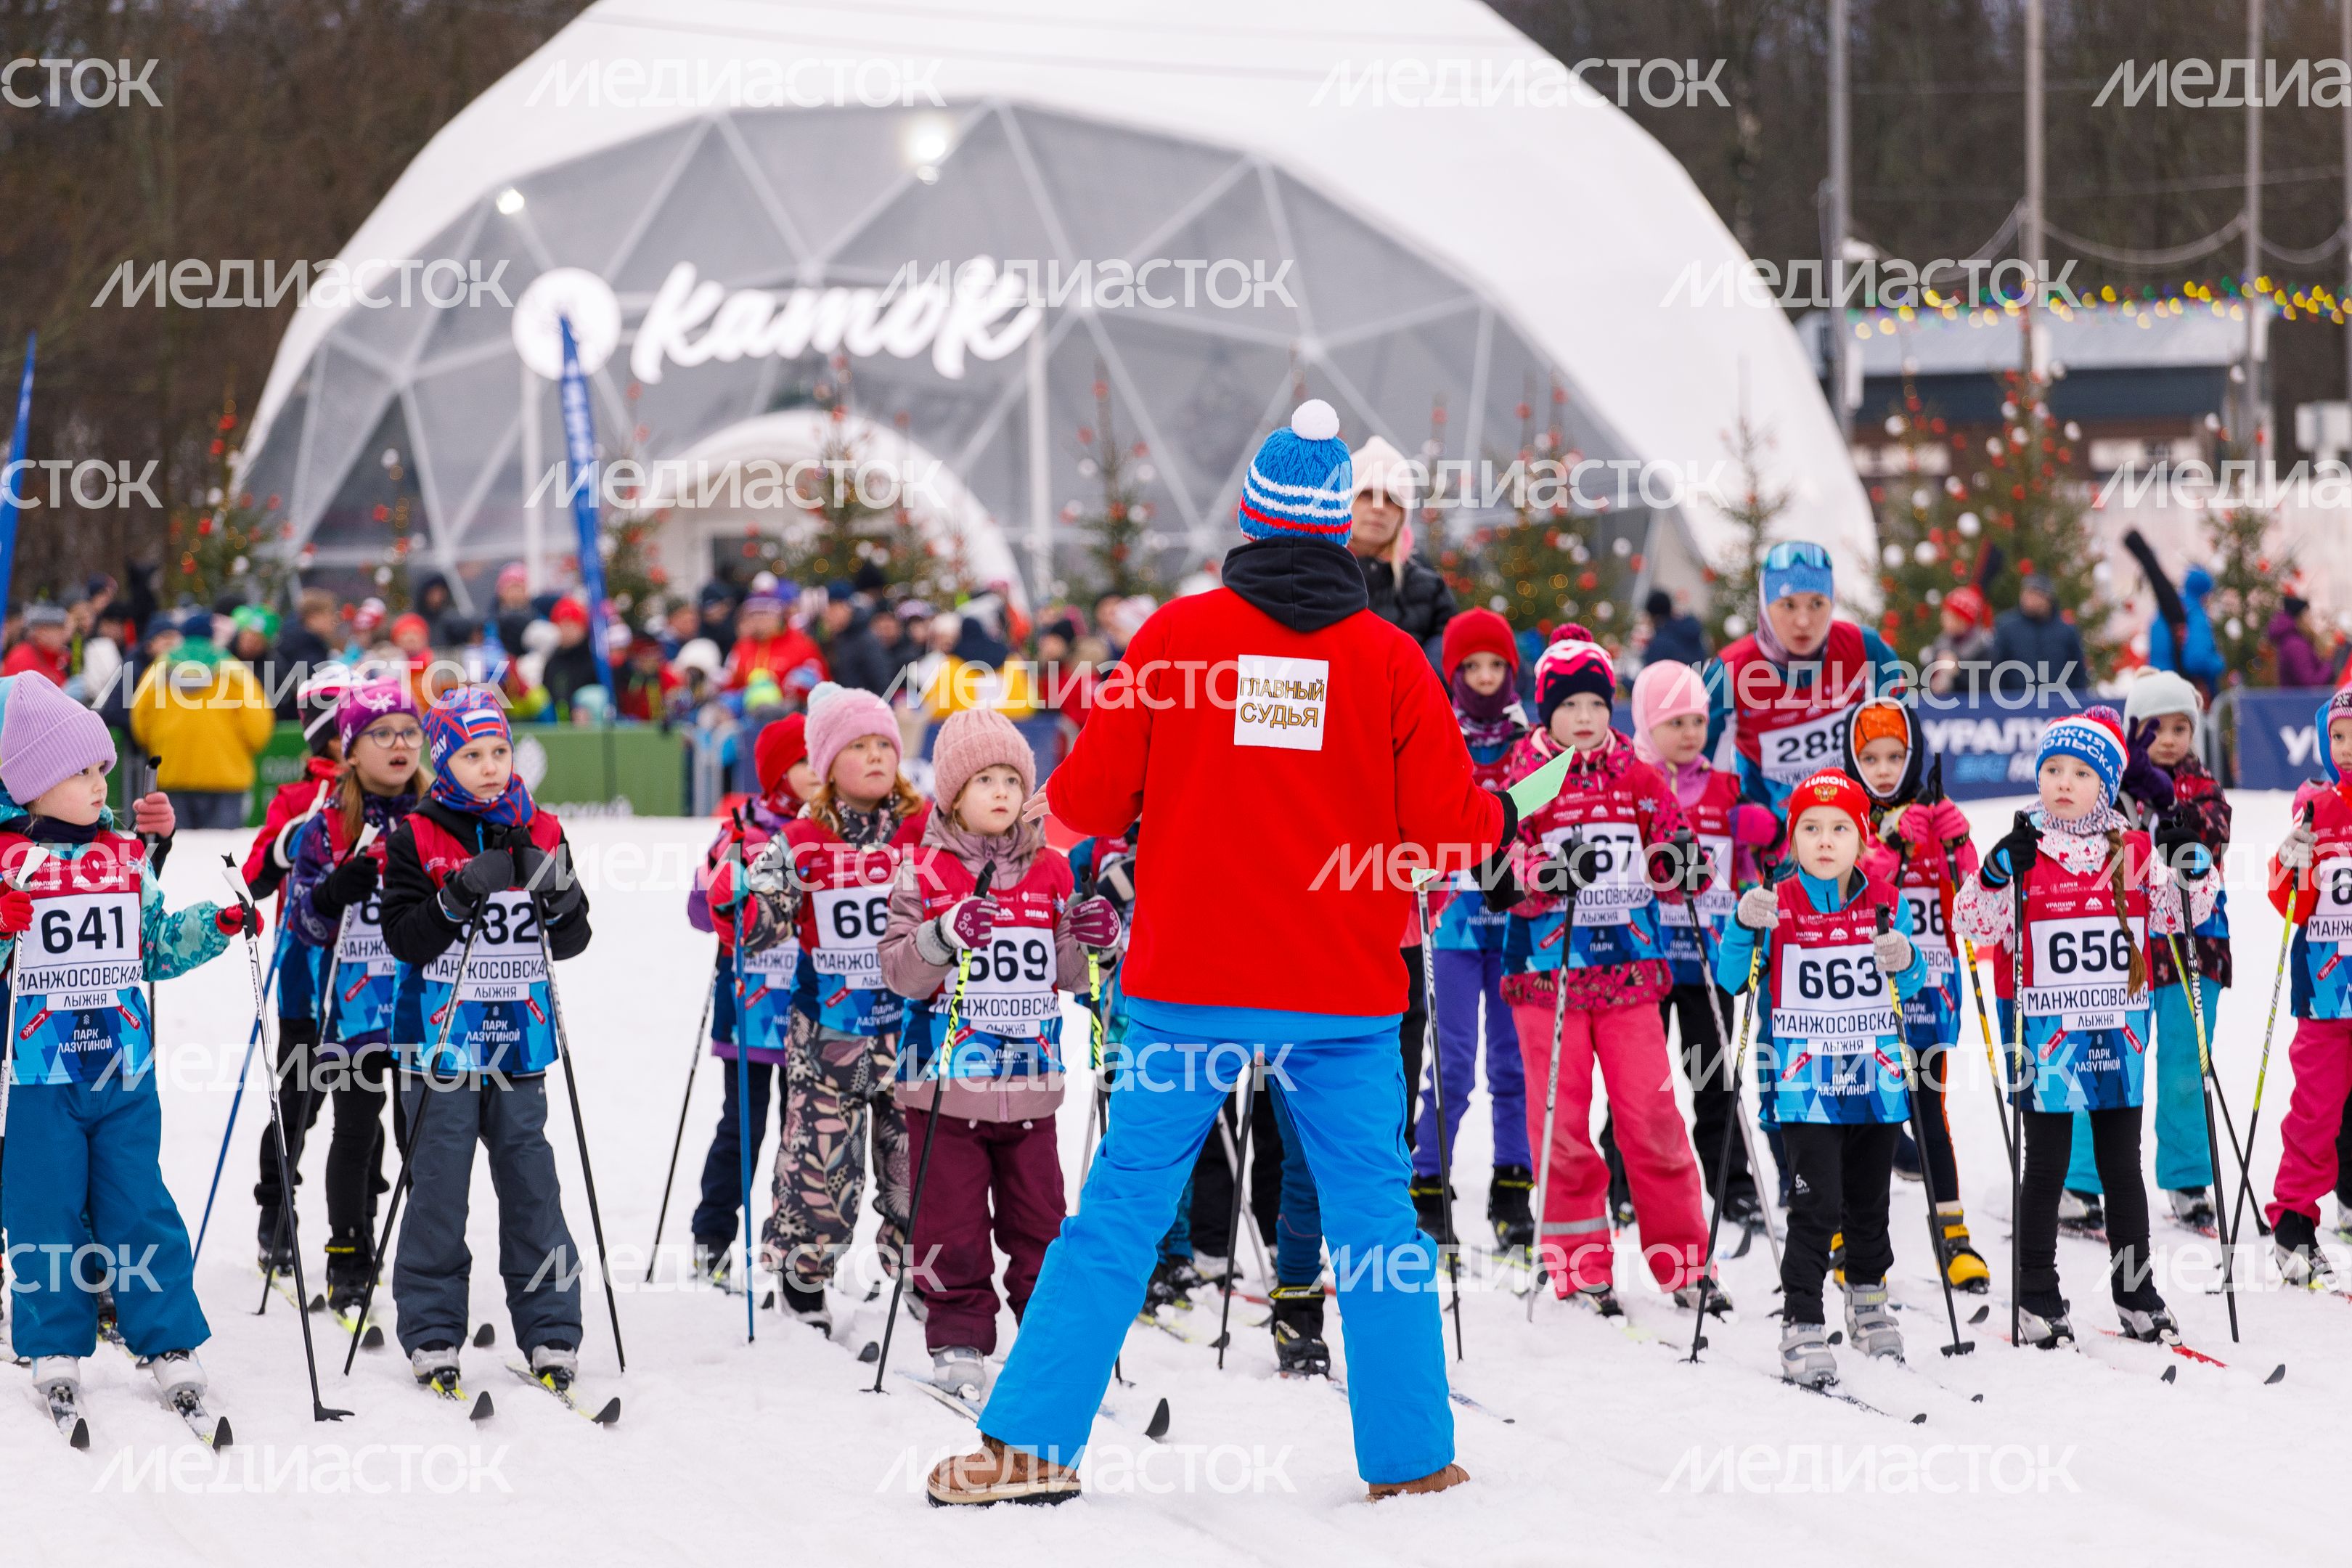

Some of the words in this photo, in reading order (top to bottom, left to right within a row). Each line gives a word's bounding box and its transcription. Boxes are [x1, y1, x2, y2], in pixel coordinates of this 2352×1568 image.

[1239, 677, 1325, 702] ГЛАВНЫЙ
[1240, 702, 1319, 729] СУДЬЯ
[41, 905, 124, 954] 641
[2049, 929, 2131, 973] 656
[1799, 956, 1882, 1000] 663
[63, 992, 107, 1008] ЛЫЖНЯ
[474, 987, 517, 998] ЛЫЖНЯ
[482, 1020, 508, 1030] ПАРК
[2078, 1013, 2114, 1028] ЛЫЖНЯ
[73, 1029, 99, 1040] ПАРК
[466, 1029, 520, 1042] ЛАЗУТИНОЙ
[57, 1035, 113, 1053] ЛАЗУТИНОЙ
[1822, 1039, 1863, 1053] ЛЫЖНЯ
[2088, 1048, 2110, 1059] ПАРК
[2074, 1056, 2120, 1072] ЛАЗУТИНОЙ
[1832, 1074, 1856, 1085] ПАРК
[1817, 1082, 1869, 1098] ЛАЗУТИНОЙ
